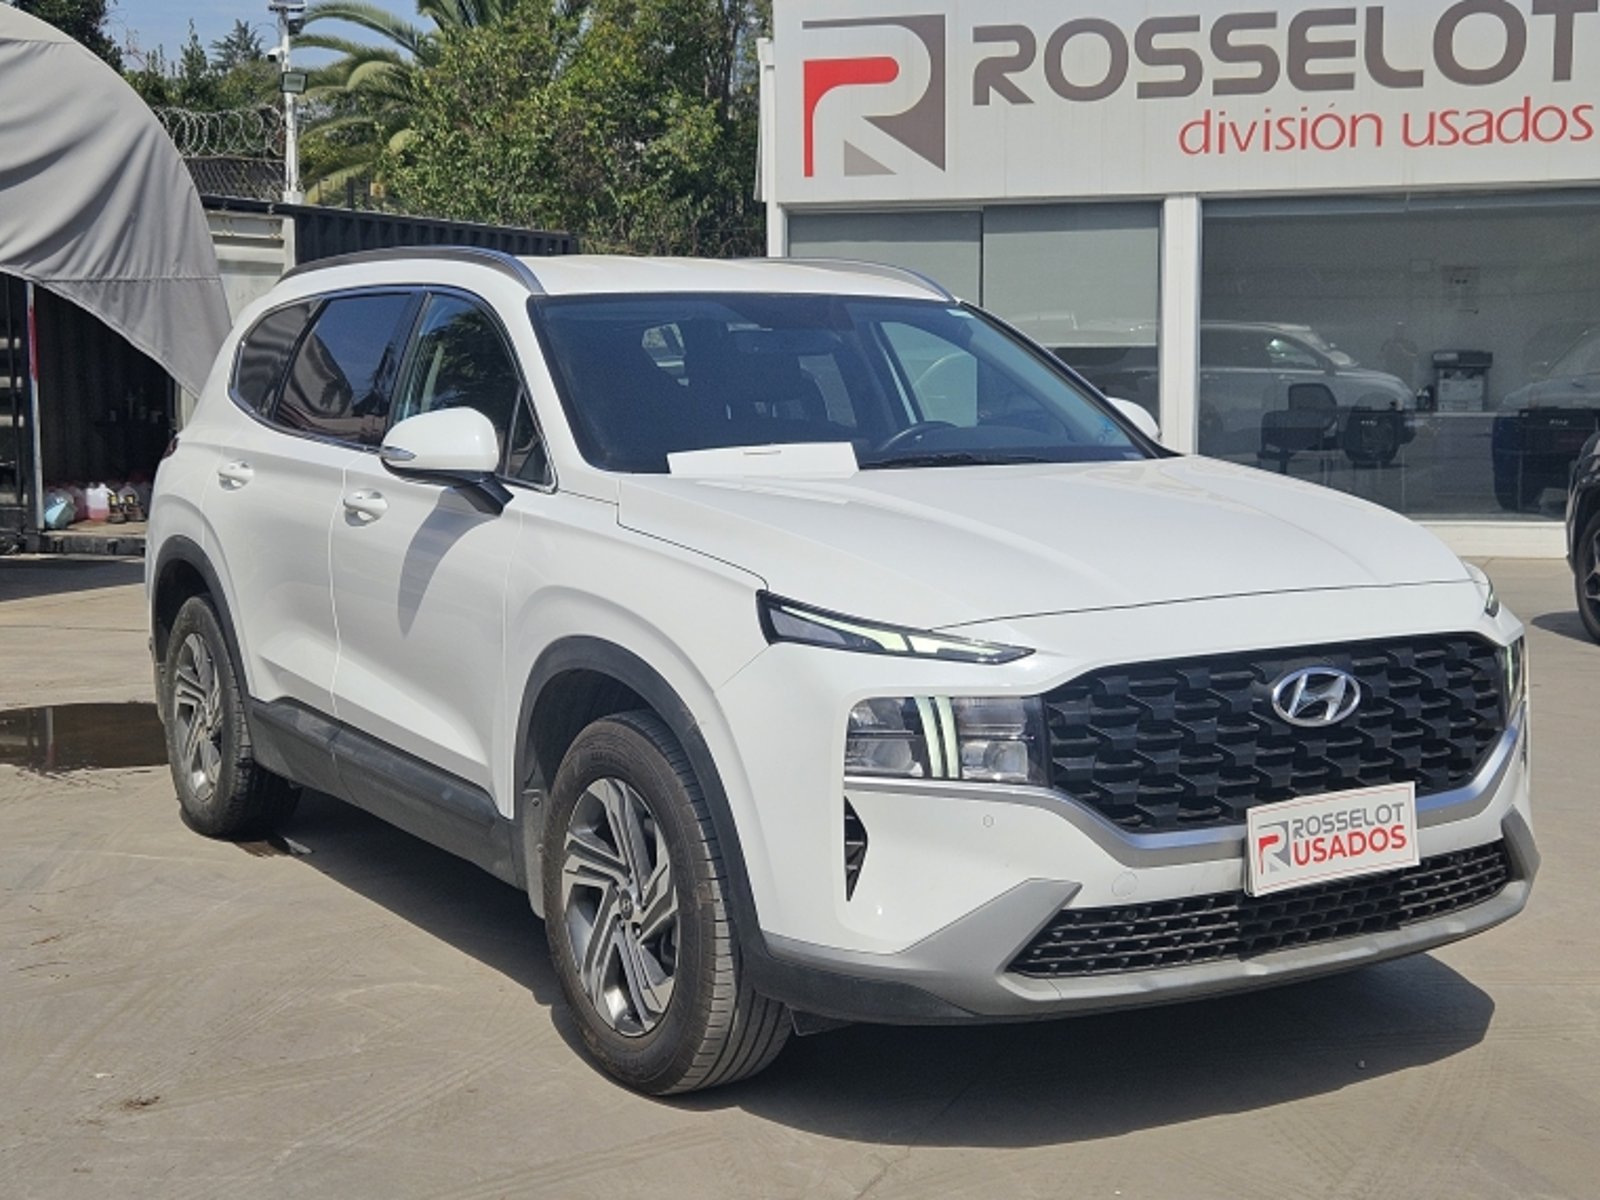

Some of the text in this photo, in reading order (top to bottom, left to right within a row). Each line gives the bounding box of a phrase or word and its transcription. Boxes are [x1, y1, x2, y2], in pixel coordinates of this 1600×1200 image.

[972, 0, 1598, 106] ROSSELOT
[1179, 96, 1595, 155] división usados
[1292, 802, 1405, 839] ROSSELOT
[1293, 824, 1408, 867] USADOS
